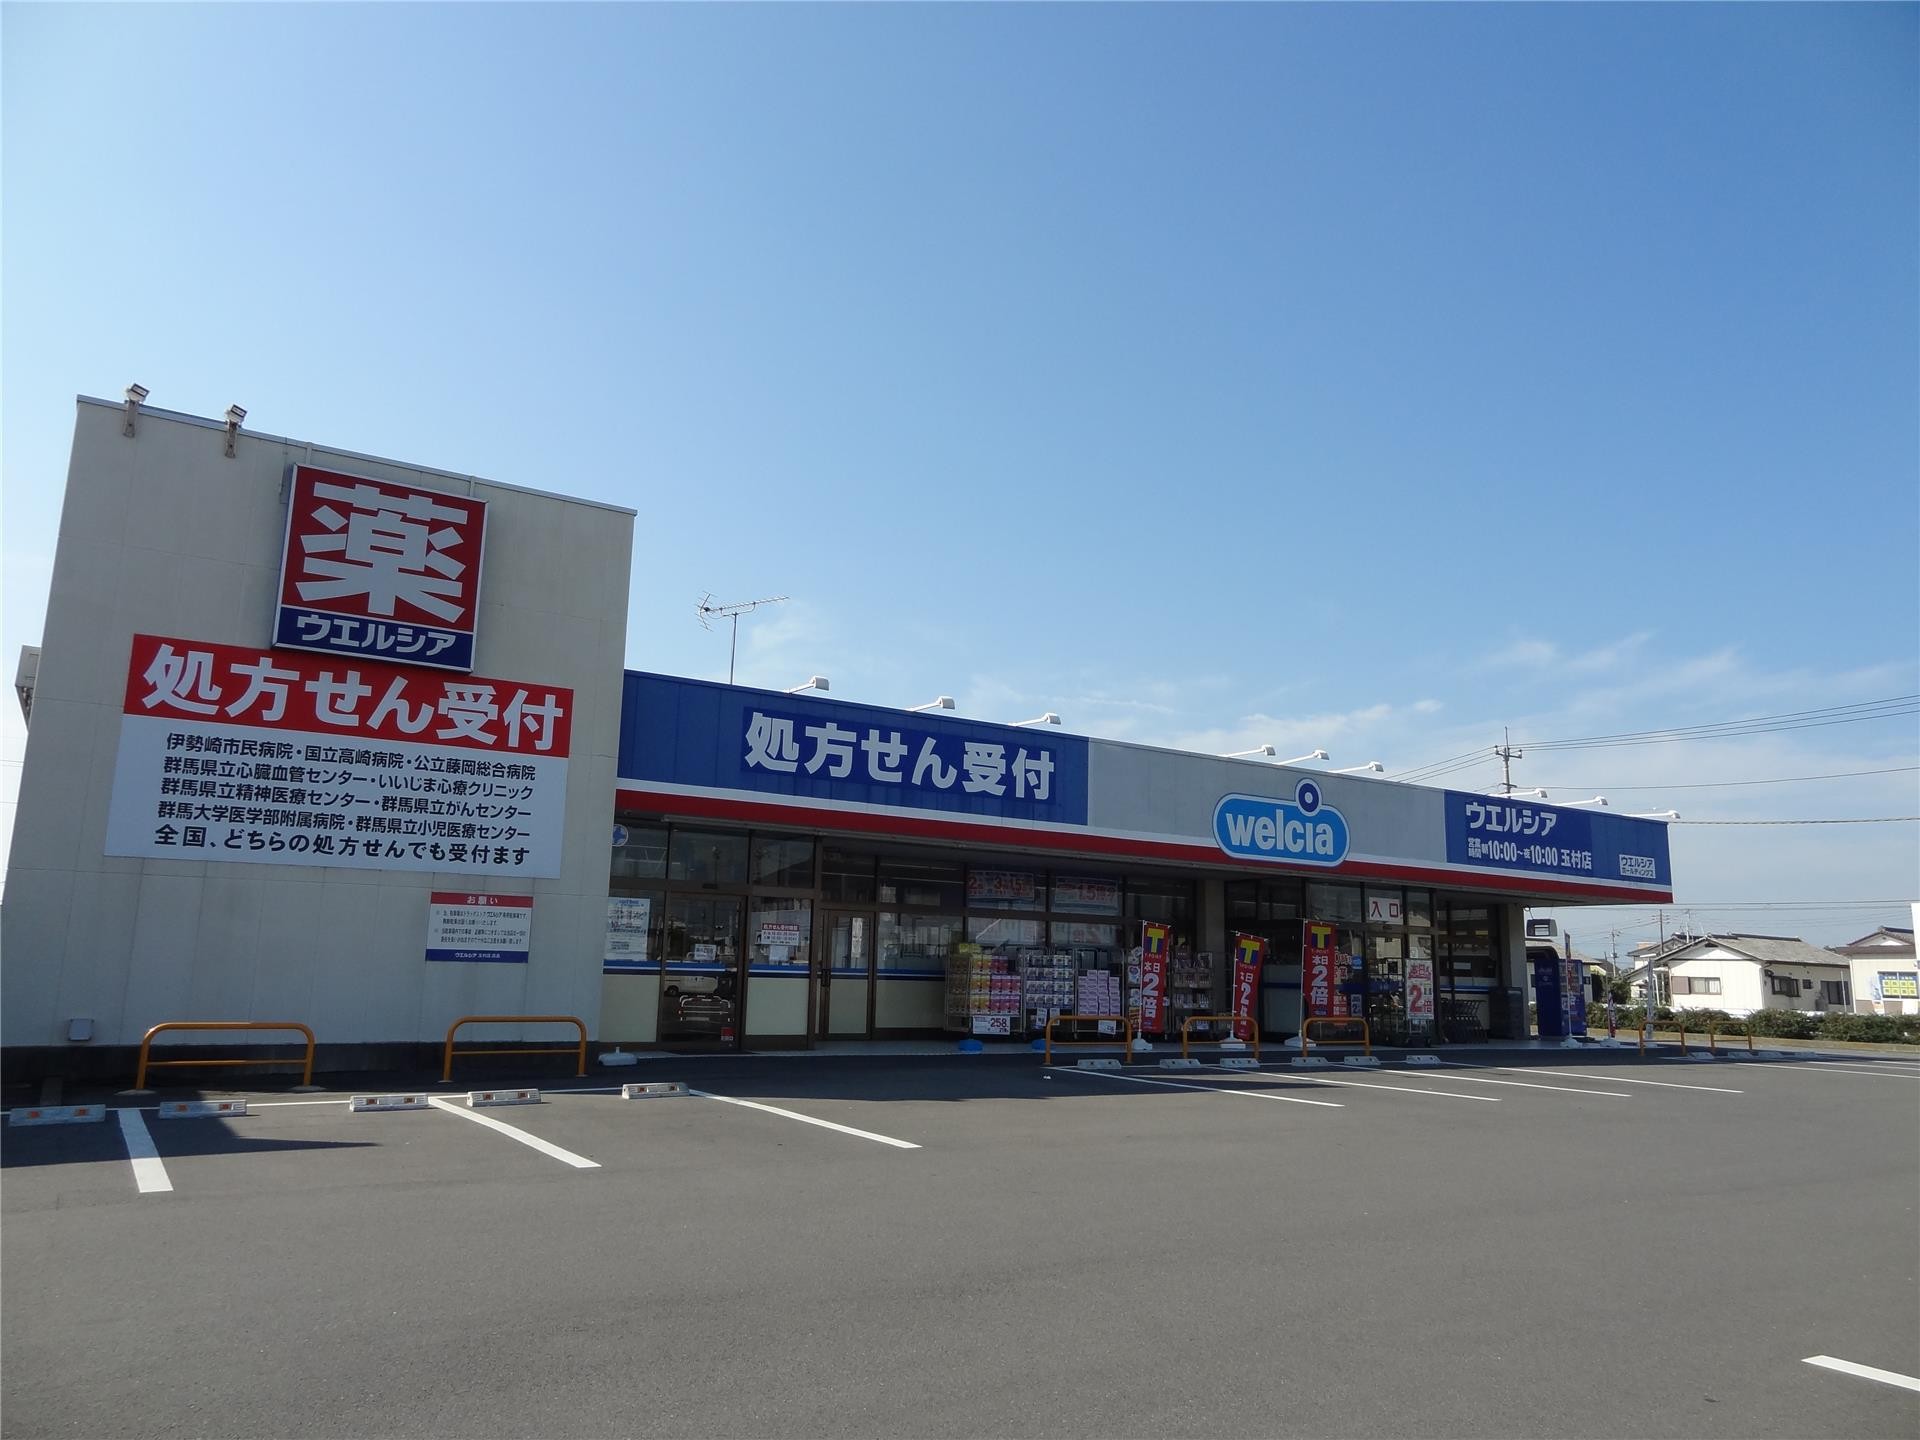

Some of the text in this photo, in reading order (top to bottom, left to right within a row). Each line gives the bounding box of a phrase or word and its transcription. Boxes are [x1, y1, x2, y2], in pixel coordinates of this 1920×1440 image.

[295, 481, 468, 623] 薬
[296, 614, 457, 656] ウエルシア
[141, 643, 563, 750] 処方せん受付
[744, 711, 1055, 800] 処方せん受付
[1465, 801, 1557, 836] ウエルシア
[1225, 808, 1334, 856] welcia
[1561, 849, 1592, 870] 玉村店
[1621, 856, 1653, 869] ウエルシア
[1371, 901, 1399, 918] 入口
[1146, 928, 1164, 953] T
[1310, 926, 1331, 949] T
[1240, 939, 1260, 964] T
[1312, 955, 1328, 965] 本日
[1144, 961, 1161, 973] 本日
